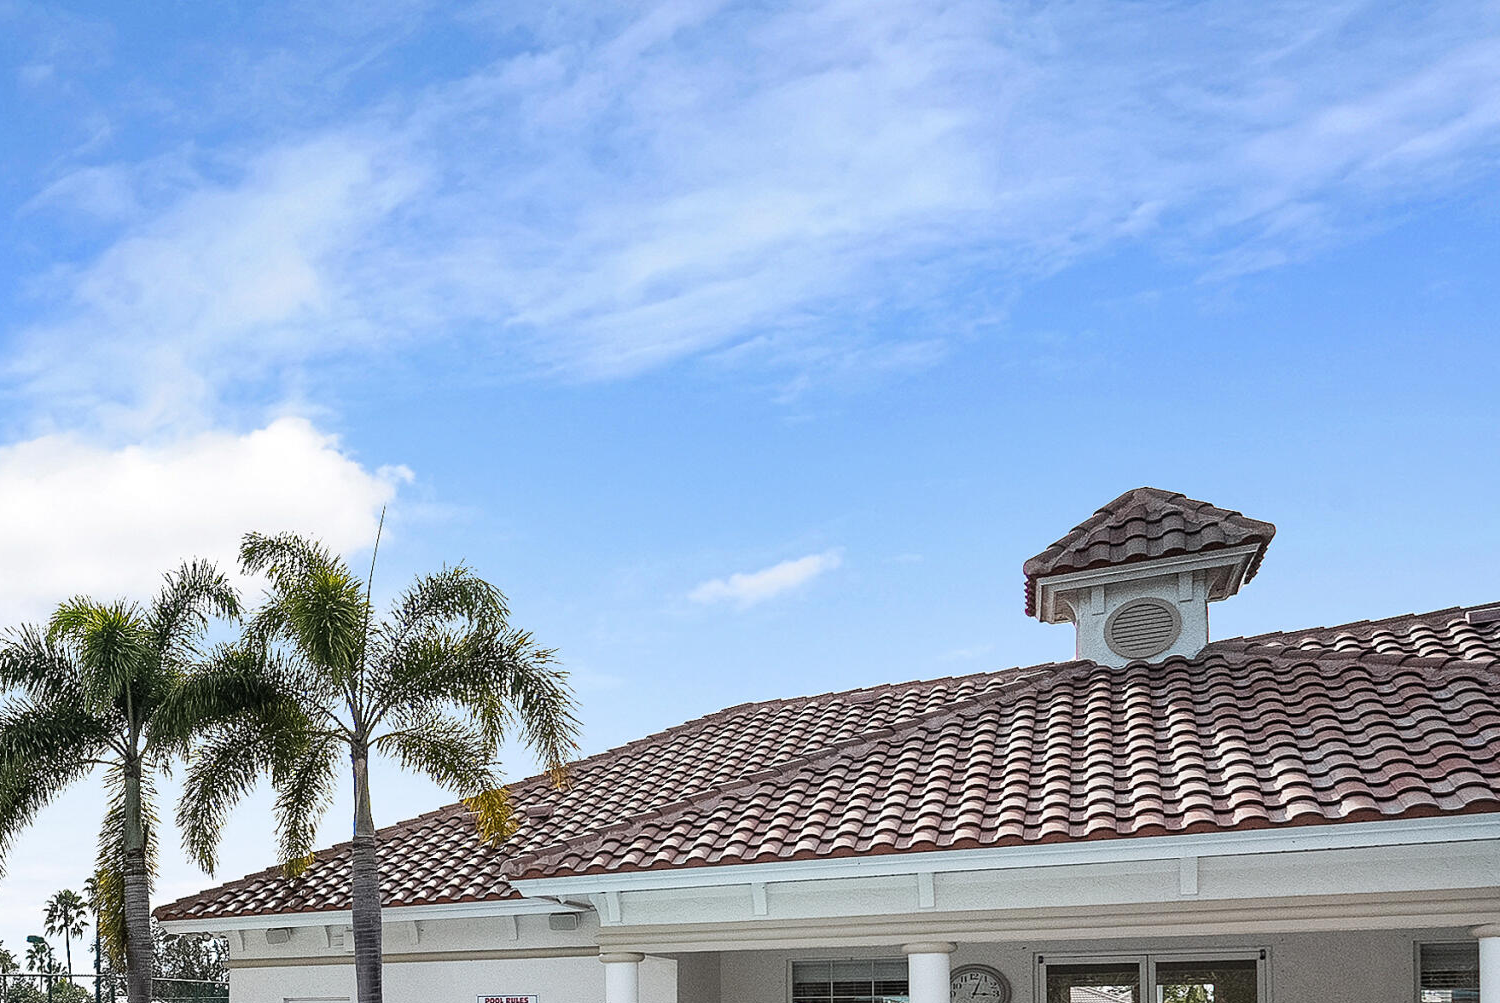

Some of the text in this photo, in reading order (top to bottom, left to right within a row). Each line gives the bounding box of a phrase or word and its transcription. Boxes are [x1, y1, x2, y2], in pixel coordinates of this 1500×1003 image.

[960, 975, 967, 983] 11
[984, 975, 988, 983] 1
[989, 981, 998, 989] 2
[505, 996, 529, 1003] RULES
